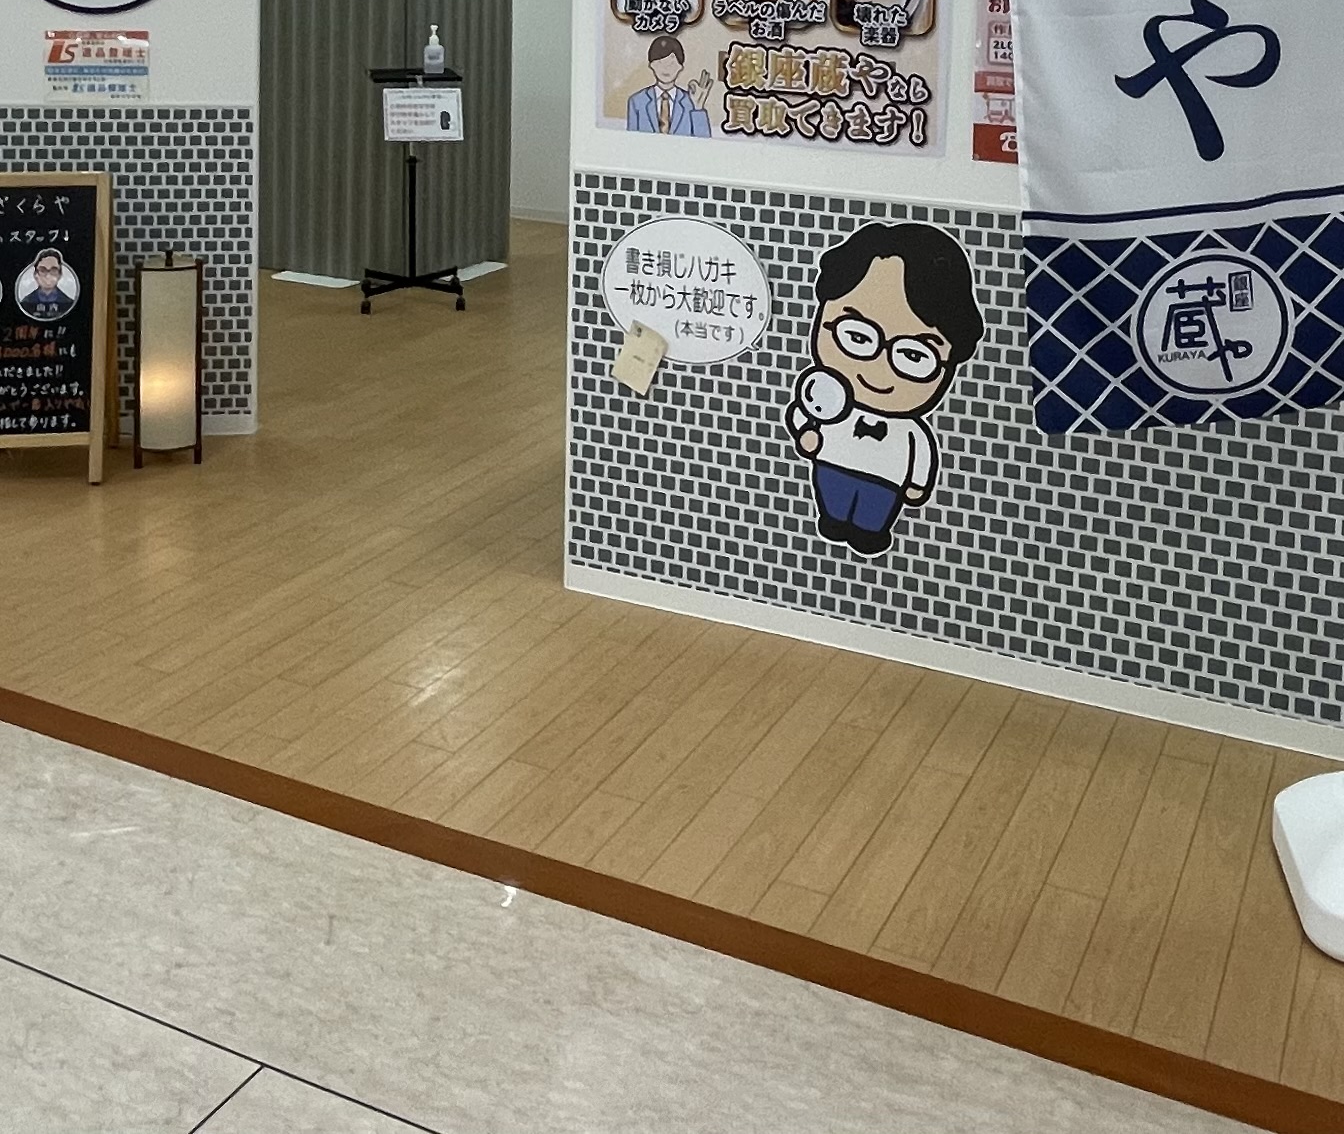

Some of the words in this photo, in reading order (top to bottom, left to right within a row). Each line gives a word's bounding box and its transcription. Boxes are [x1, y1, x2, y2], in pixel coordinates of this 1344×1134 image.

[633, 15, 680, 32] カメラ
[750, 20, 786, 41] お酒
[861, 25, 900, 47] 楽器
[723, 44, 933, 104] 銀座蔵やなら
[722, 93, 928, 146] 買取できます!
[624, 246, 738, 284] 書き損じハガキ
[614, 282, 765, 322] 一枚から大歓迎です。
[1157, 350, 1206, 364] KURAYA
